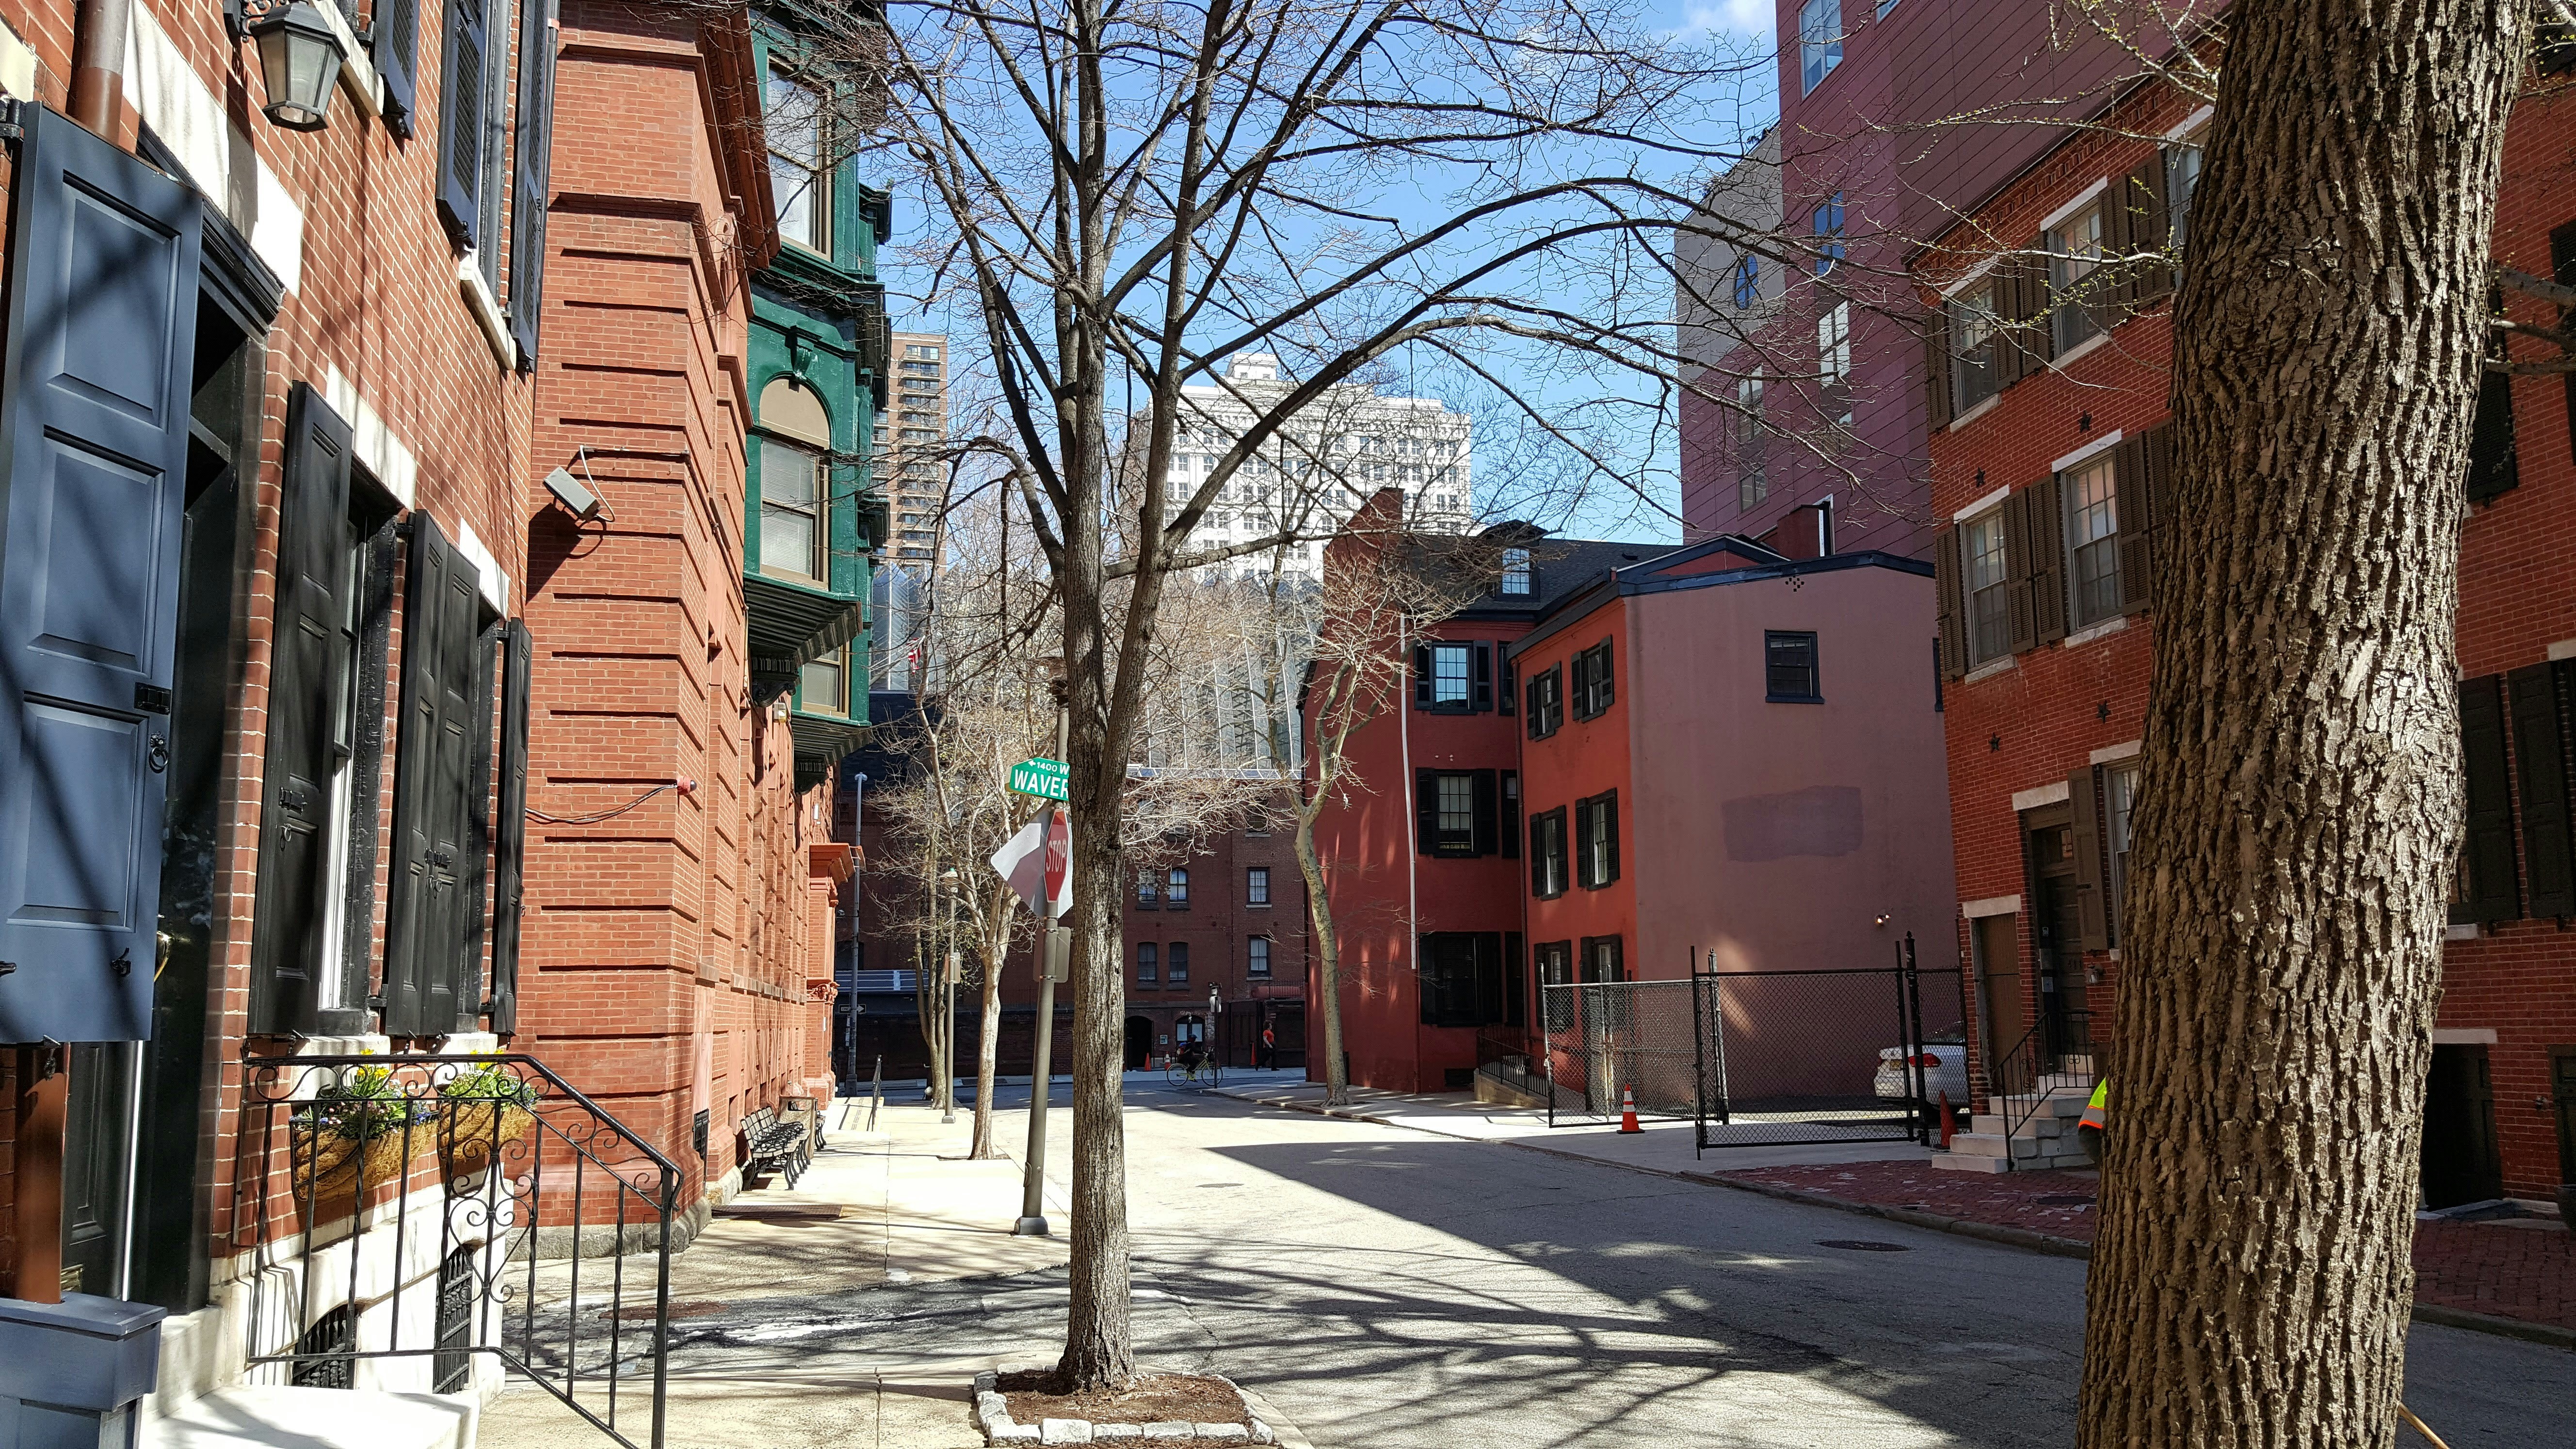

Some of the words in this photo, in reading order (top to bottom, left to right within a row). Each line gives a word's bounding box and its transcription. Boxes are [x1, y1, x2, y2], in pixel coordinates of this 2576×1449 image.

[1037, 761, 1057, 772] 1400
[1060, 764, 1070, 775] W
[1014, 769, 1069, 799] WAVER
[1046, 839, 1067, 872] STOP
